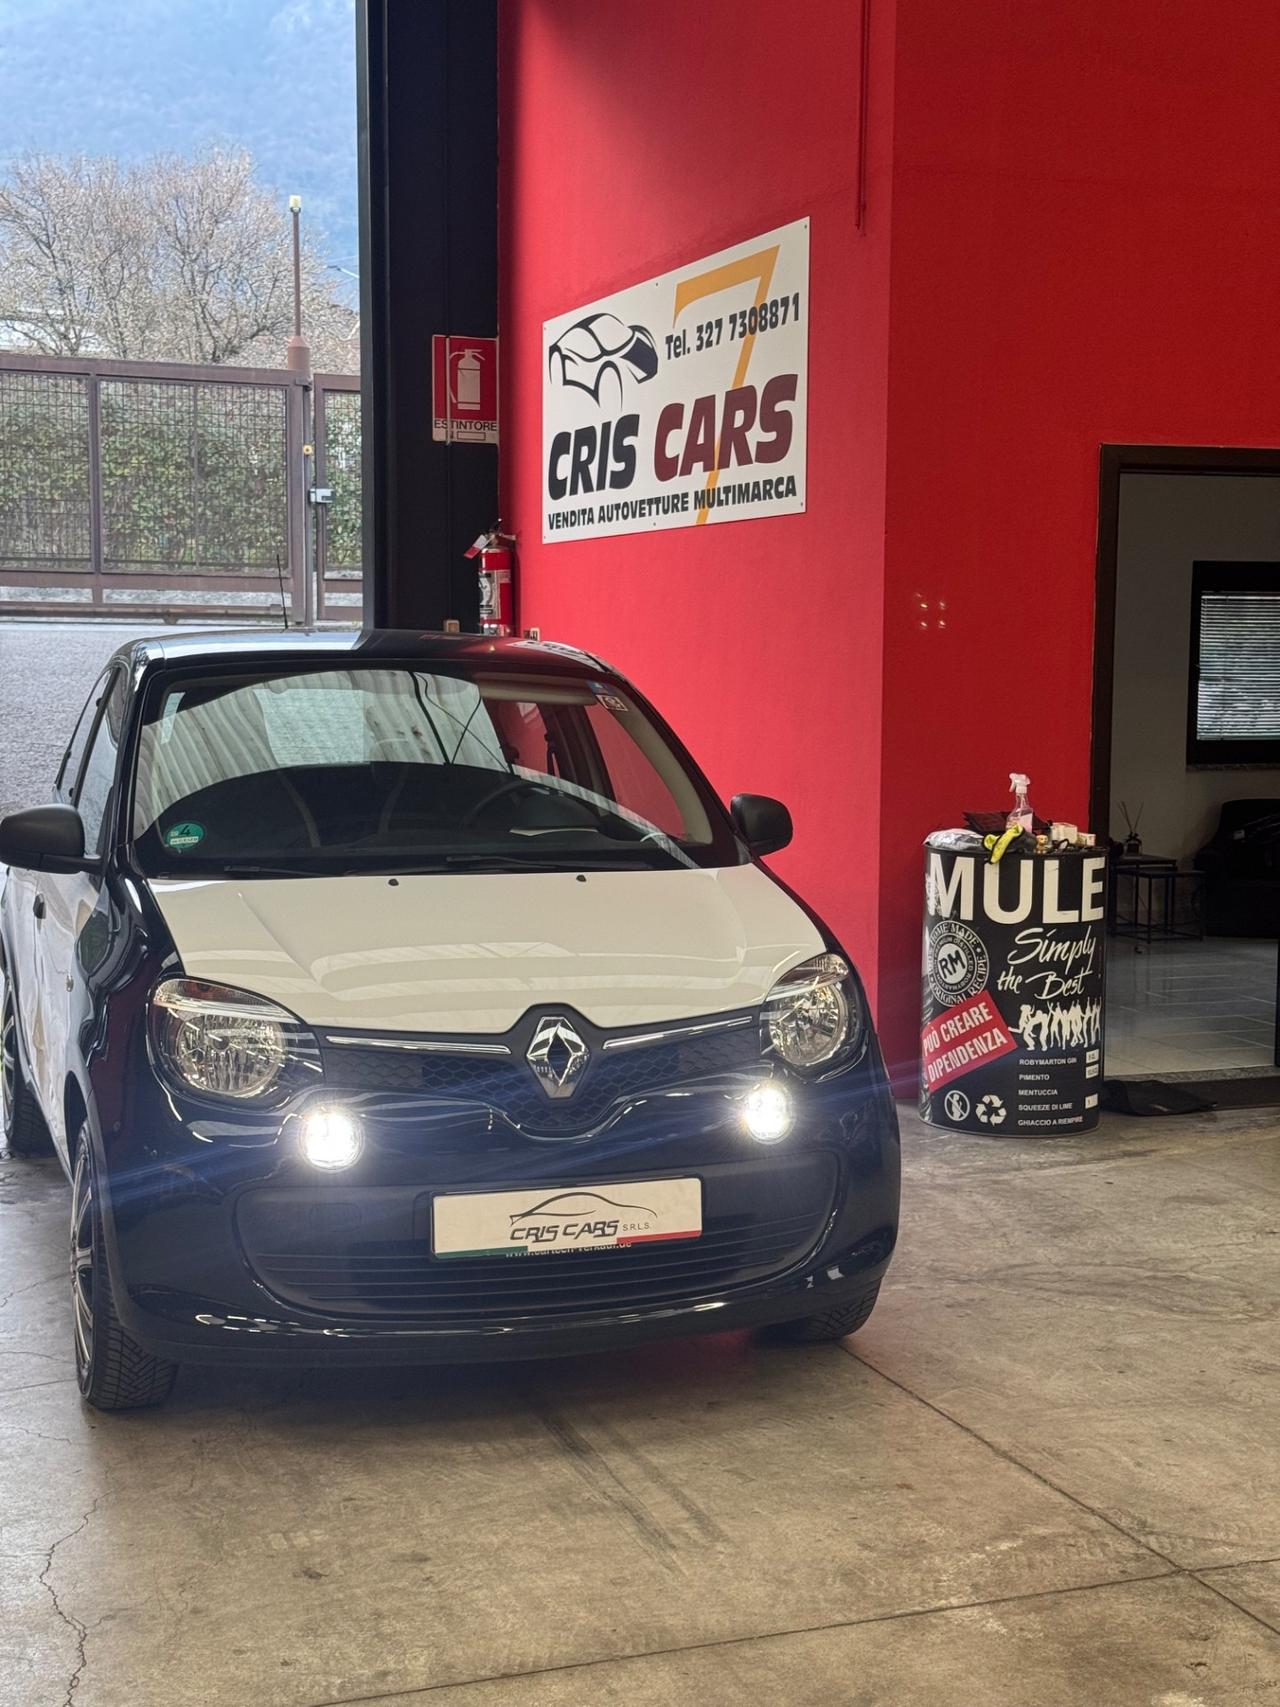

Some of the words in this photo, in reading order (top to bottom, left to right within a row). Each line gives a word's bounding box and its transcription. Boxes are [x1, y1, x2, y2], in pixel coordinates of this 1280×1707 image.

[665, 334, 691, 360] Tel.
[696, 317, 723, 352] 327
[729, 292, 800, 342] 7308871
[434, 418, 498, 432] ESTINTORE
[548, 413, 640, 501] CRIS
[654, 373, 798, 482] CARS
[548, 506, 595, 530] VENDITA
[598, 492, 689, 524] AUTOVETTURE
[694, 475, 797, 510] MULTIMARCA
[181, 825, 191, 836] 4
[928, 852, 1106, 924] MULE
[950, 923, 979, 948] MADE
[1007, 925, 1097, 975] Simply
[939, 949, 966, 979] RM
[997, 966, 1023, 995] the
[1025, 966, 1093, 999] Best
[922, 1026, 941, 1057] PUÒ
[940, 1002, 993, 1042] CREARE
[927, 1027, 1008, 1083] DIPENDENZA
[1019, 1058, 1066, 1066] ROBYMARTON
[1060, 1102, 1073, 1110] LIME
[510, 1225, 560, 1244] CRIS
[562, 1220, 620, 1241] CARS
